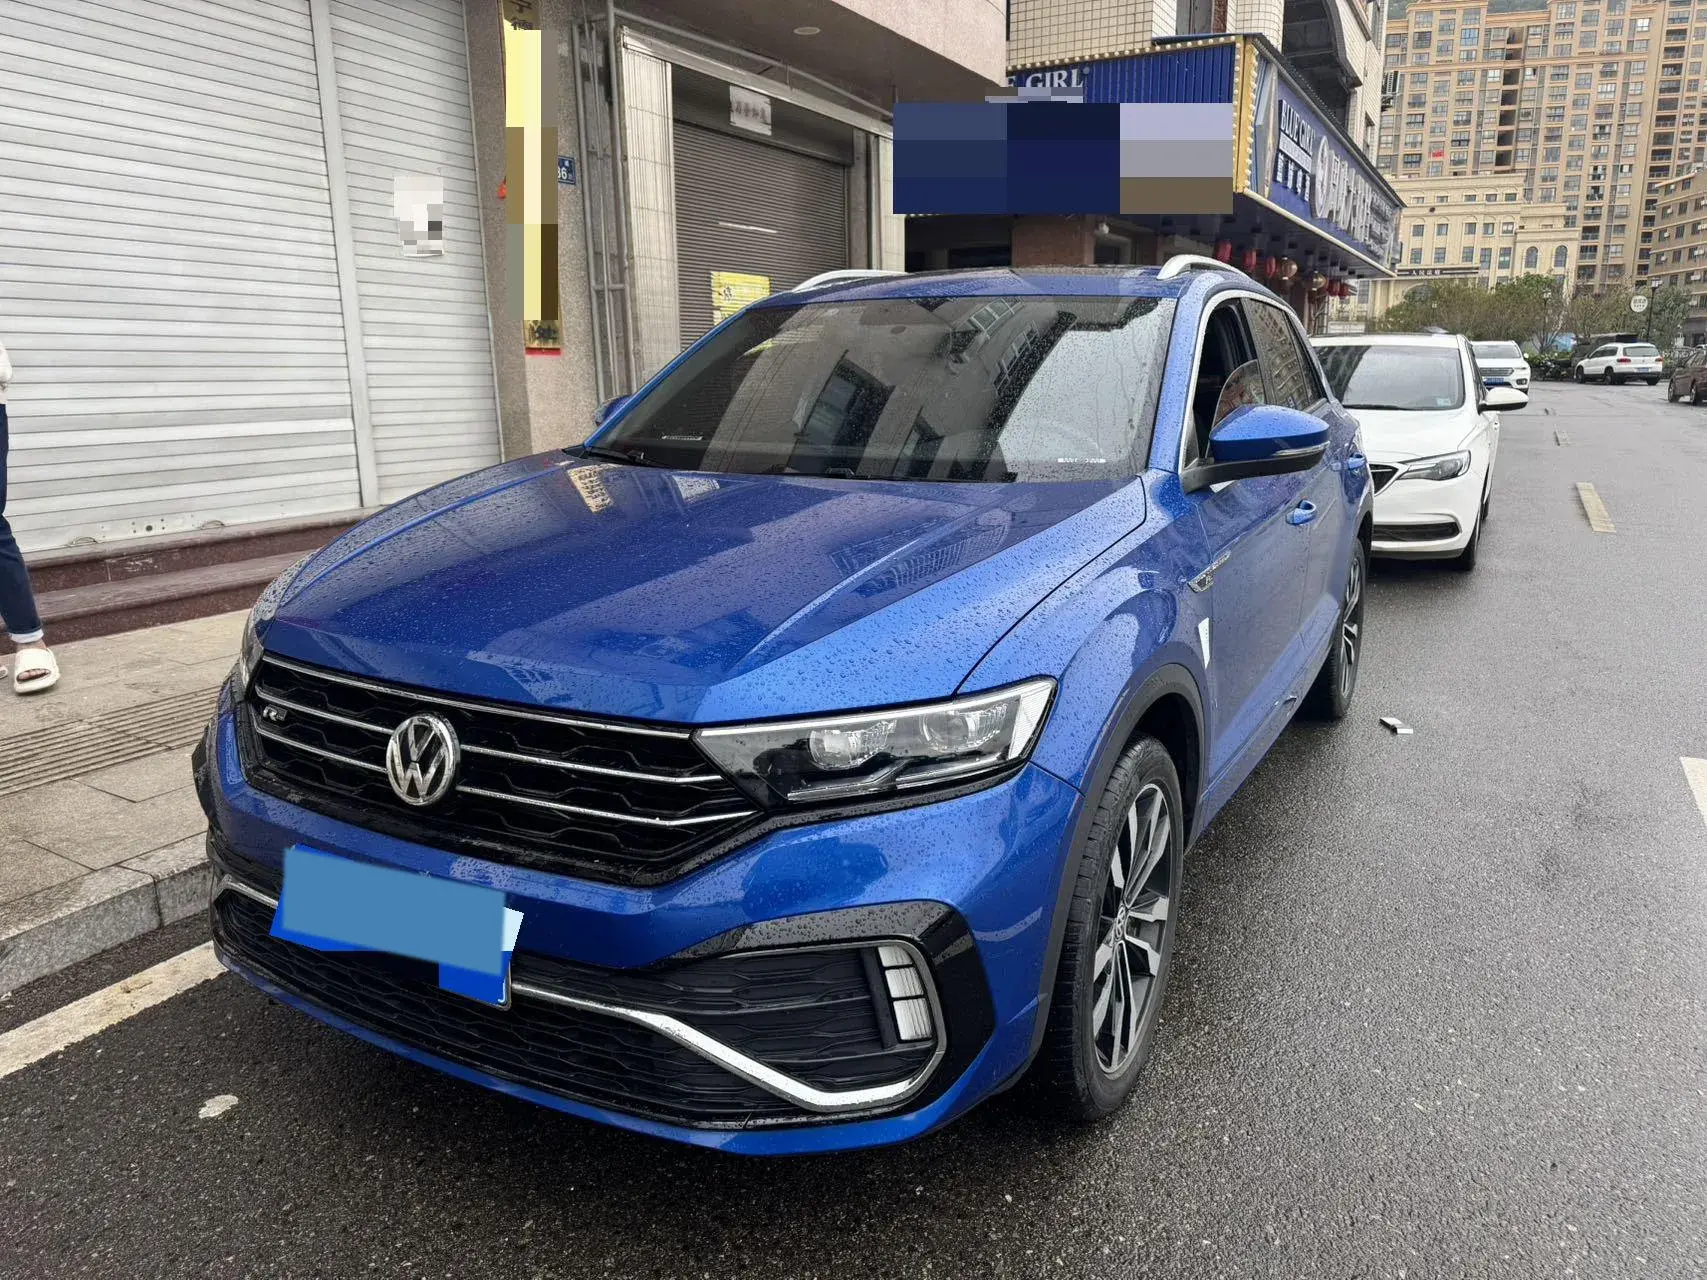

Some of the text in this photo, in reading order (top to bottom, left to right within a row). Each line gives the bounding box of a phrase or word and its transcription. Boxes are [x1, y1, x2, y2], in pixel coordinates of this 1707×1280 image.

[1025, 68, 1084, 88] GIRL
[1281, 99, 1299, 142] BLUE
[1299, 119, 1315, 156] GIRL
